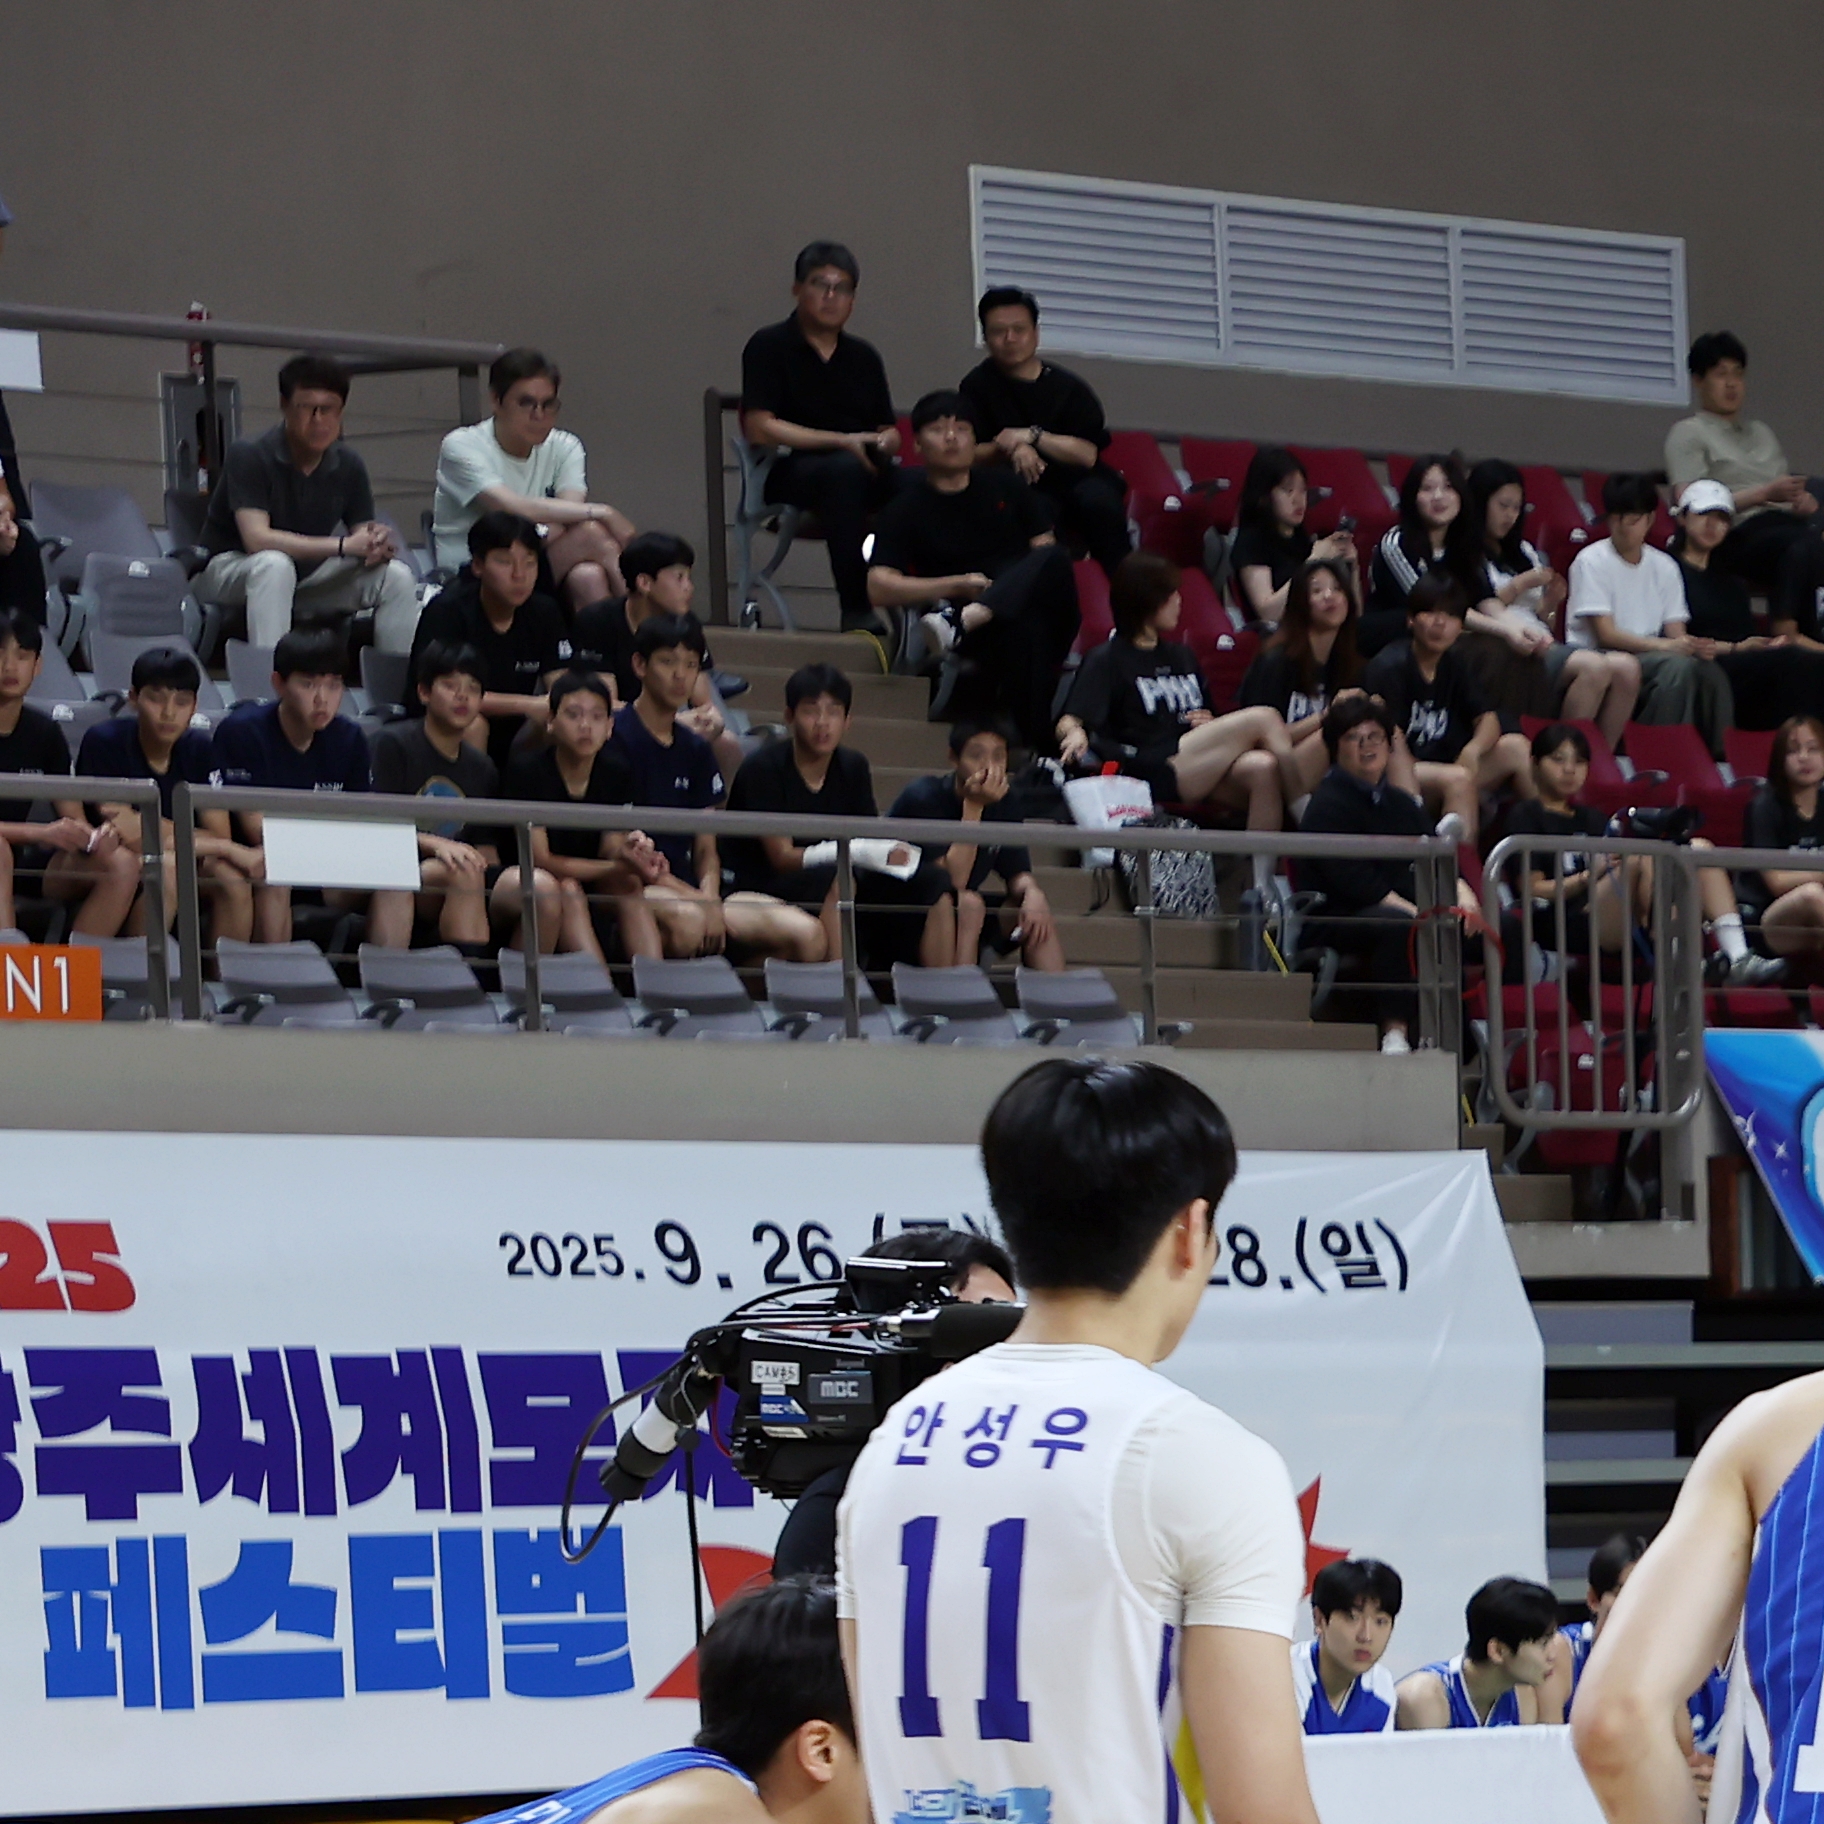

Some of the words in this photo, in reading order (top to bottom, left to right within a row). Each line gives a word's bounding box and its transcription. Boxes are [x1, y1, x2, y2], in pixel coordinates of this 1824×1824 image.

[499, 1231, 646, 1282] 2025.
[654, 1218, 734, 1291] 9.
[1206, 1214, 1410, 1295] 8.(일)
[895, 1401, 1089, 1470] 안성우
[40, 1526, 635, 1714] 페스티벌
[897, 1515, 1034, 1743] 11
